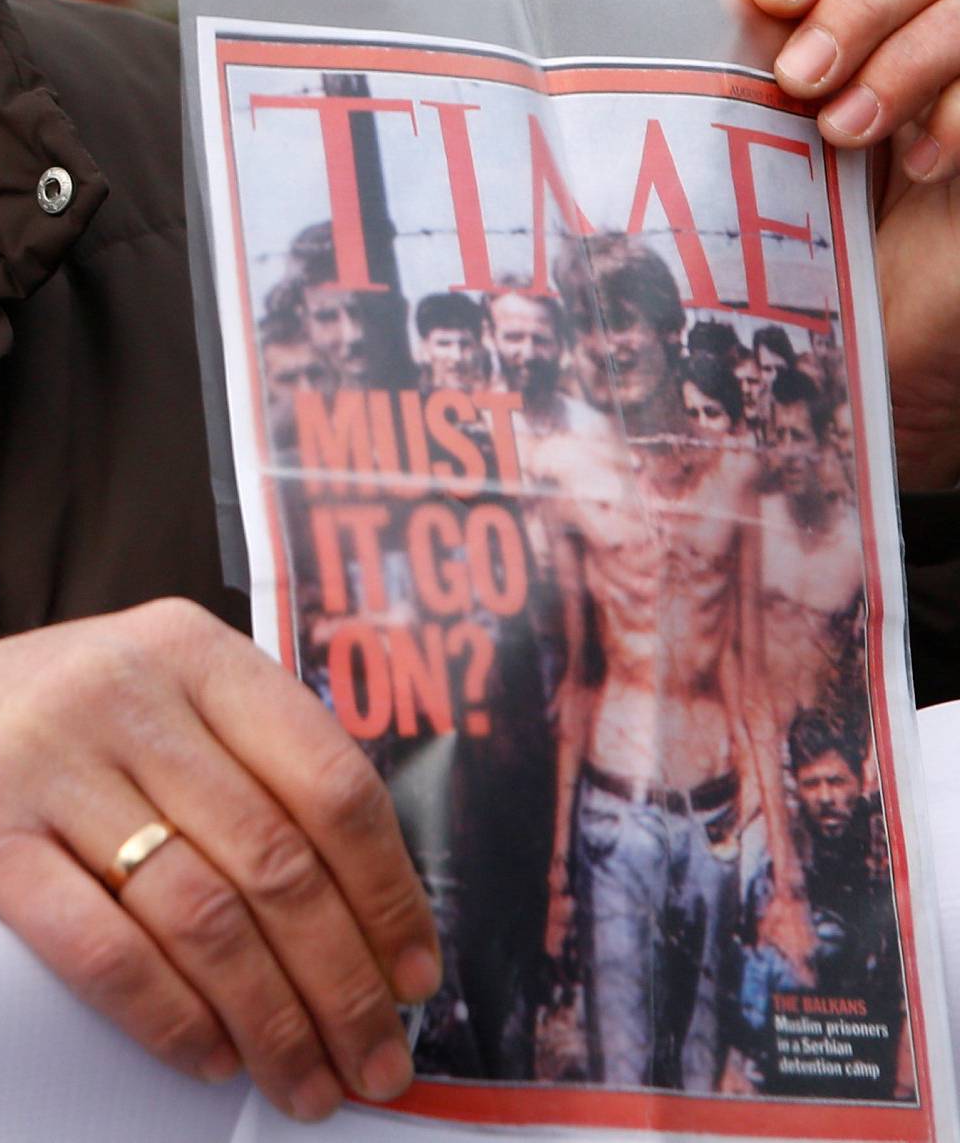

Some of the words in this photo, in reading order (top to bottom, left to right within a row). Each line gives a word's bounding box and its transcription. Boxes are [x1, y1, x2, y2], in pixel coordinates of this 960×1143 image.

[251, 95, 831, 332] TIME
[293, 389, 524, 501] MUST
[310, 501, 391, 616] IT
[406, 504, 529, 618] GO
[328, 620, 495, 739] ON?
[773, 995, 797, 1013] THE
[803, 997, 868, 1016] BALKANS
[774, 1014, 822, 1035] Muslim
[826, 1020, 889, 1039] prisoners
[777, 1035, 790, 1052] in
[801, 1036, 853, 1056] Serbian
[778, 1056, 842, 1076] detention
[845, 1061, 880, 1080] camp
